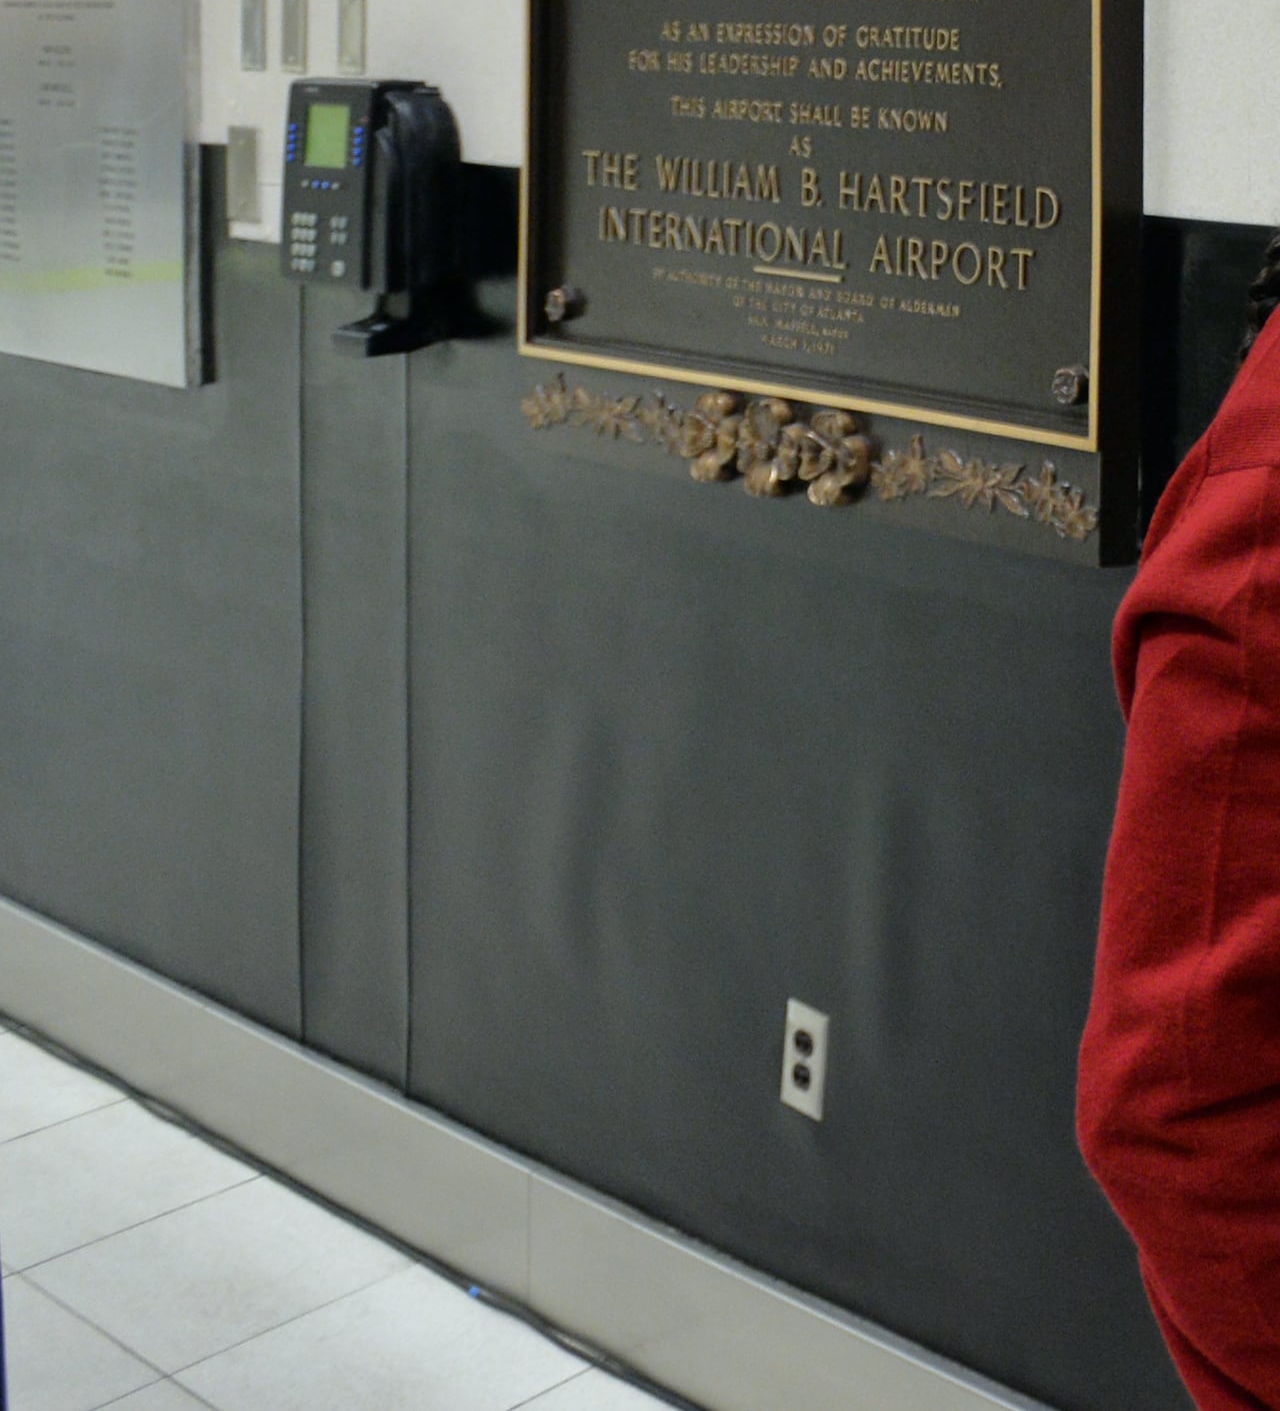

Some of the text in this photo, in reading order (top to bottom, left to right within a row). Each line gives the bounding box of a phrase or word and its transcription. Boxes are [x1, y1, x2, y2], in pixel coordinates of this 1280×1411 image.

[661, 20, 961, 51] AS AN EXPRESSION OF GRATITUDE
[628, 48, 661, 72] FOR
[666, 50, 693, 74] HIS
[700, 51, 800, 77] LEADERSHIP
[808, 57, 848, 81] AND
[671, 94, 949, 132] THIS AIRPORT SHALL BE KNOWN
[789, 135, 813, 159] AS
[582, 149, 1060, 230] THE WILLIAM B. HARTSFIELD
[599, 205, 1035, 290] INTERNATIONAL AIRPORT
